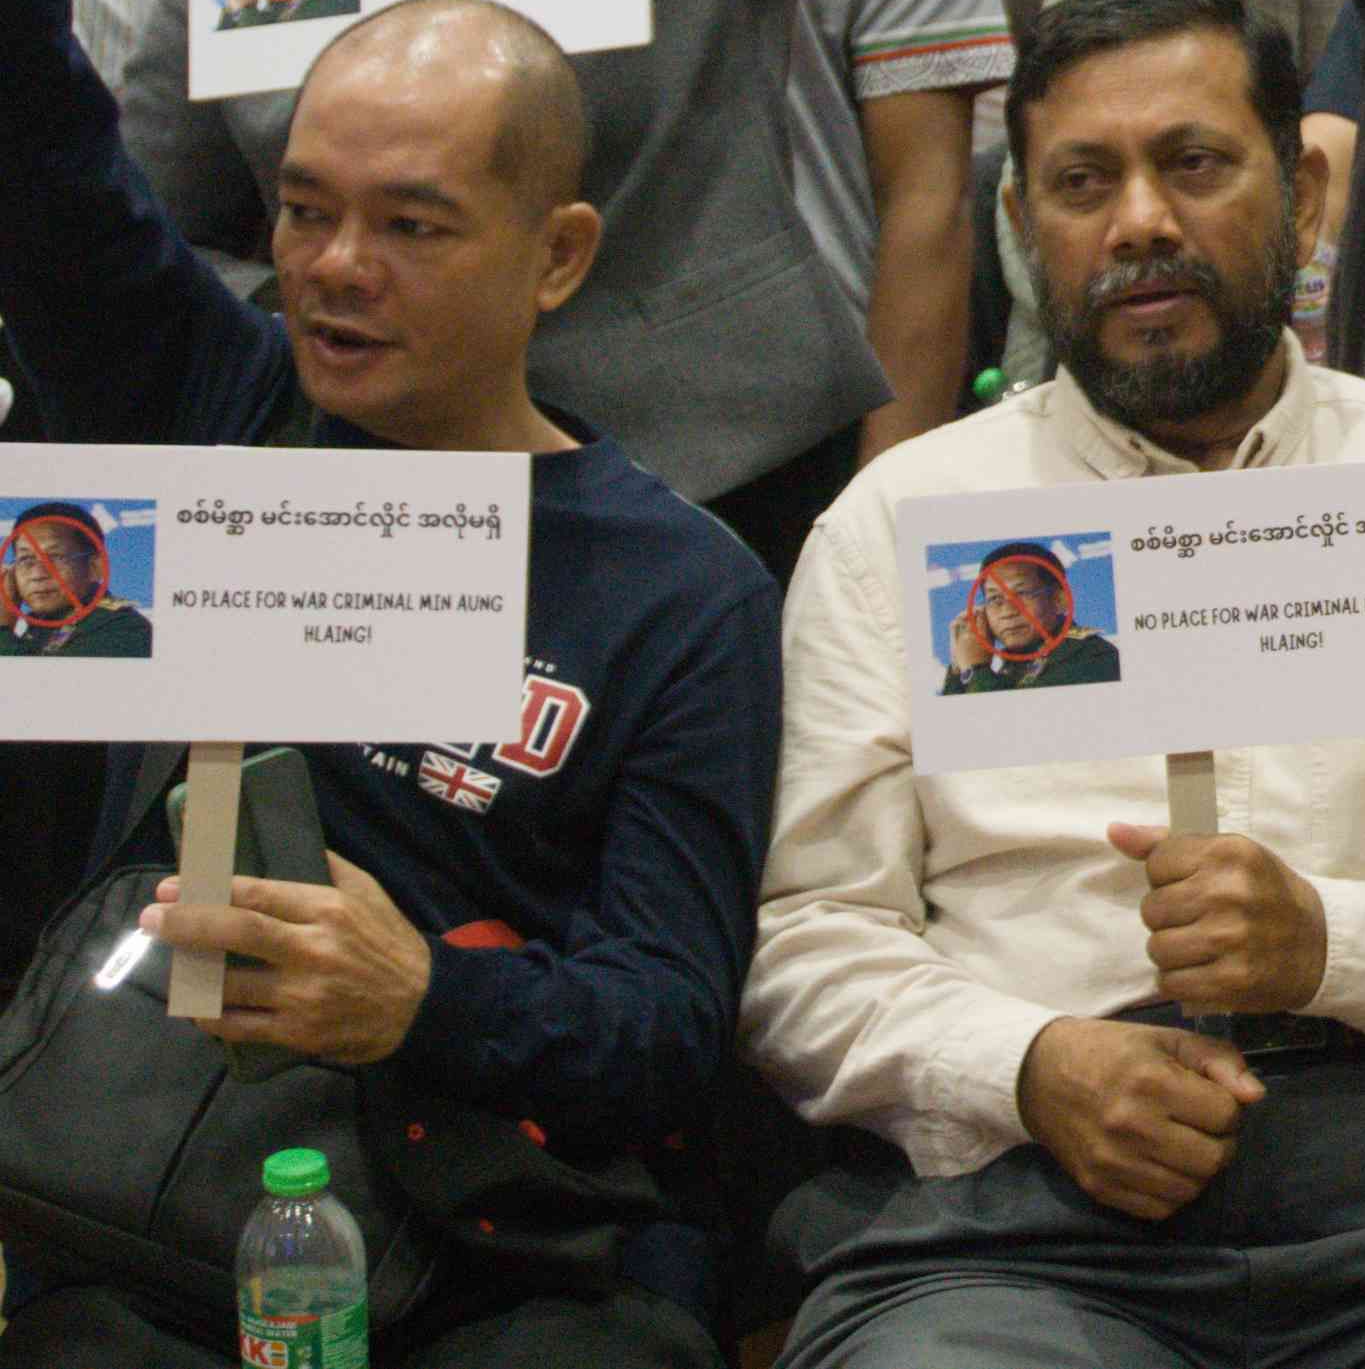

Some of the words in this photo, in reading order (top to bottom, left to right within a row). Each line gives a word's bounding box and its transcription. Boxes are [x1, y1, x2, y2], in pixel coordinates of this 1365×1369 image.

[1209, 512, 1349, 548] မင်းအောင်လှိုင်
[172, 590, 197, 607] NO
[202, 590, 251, 608] PLACE
[256, 590, 286, 609] FOR
[291, 592, 327, 610] WAR
[332, 592, 414, 610] CRIMINAL
[419, 594, 452, 611] MIN
[456, 594, 503, 612] AUNG
[1135, 614, 1157, 630] NO
[1161, 609, 1208, 629] PLACE
[1212, 607, 1240, 624] FOR
[1245, 604, 1279, 622] WAR
[1283, 597, 1360, 619] CRIMINAL
[304, 625, 372, 644] HLAING!
[1260, 631, 1323, 652] HLAING!
